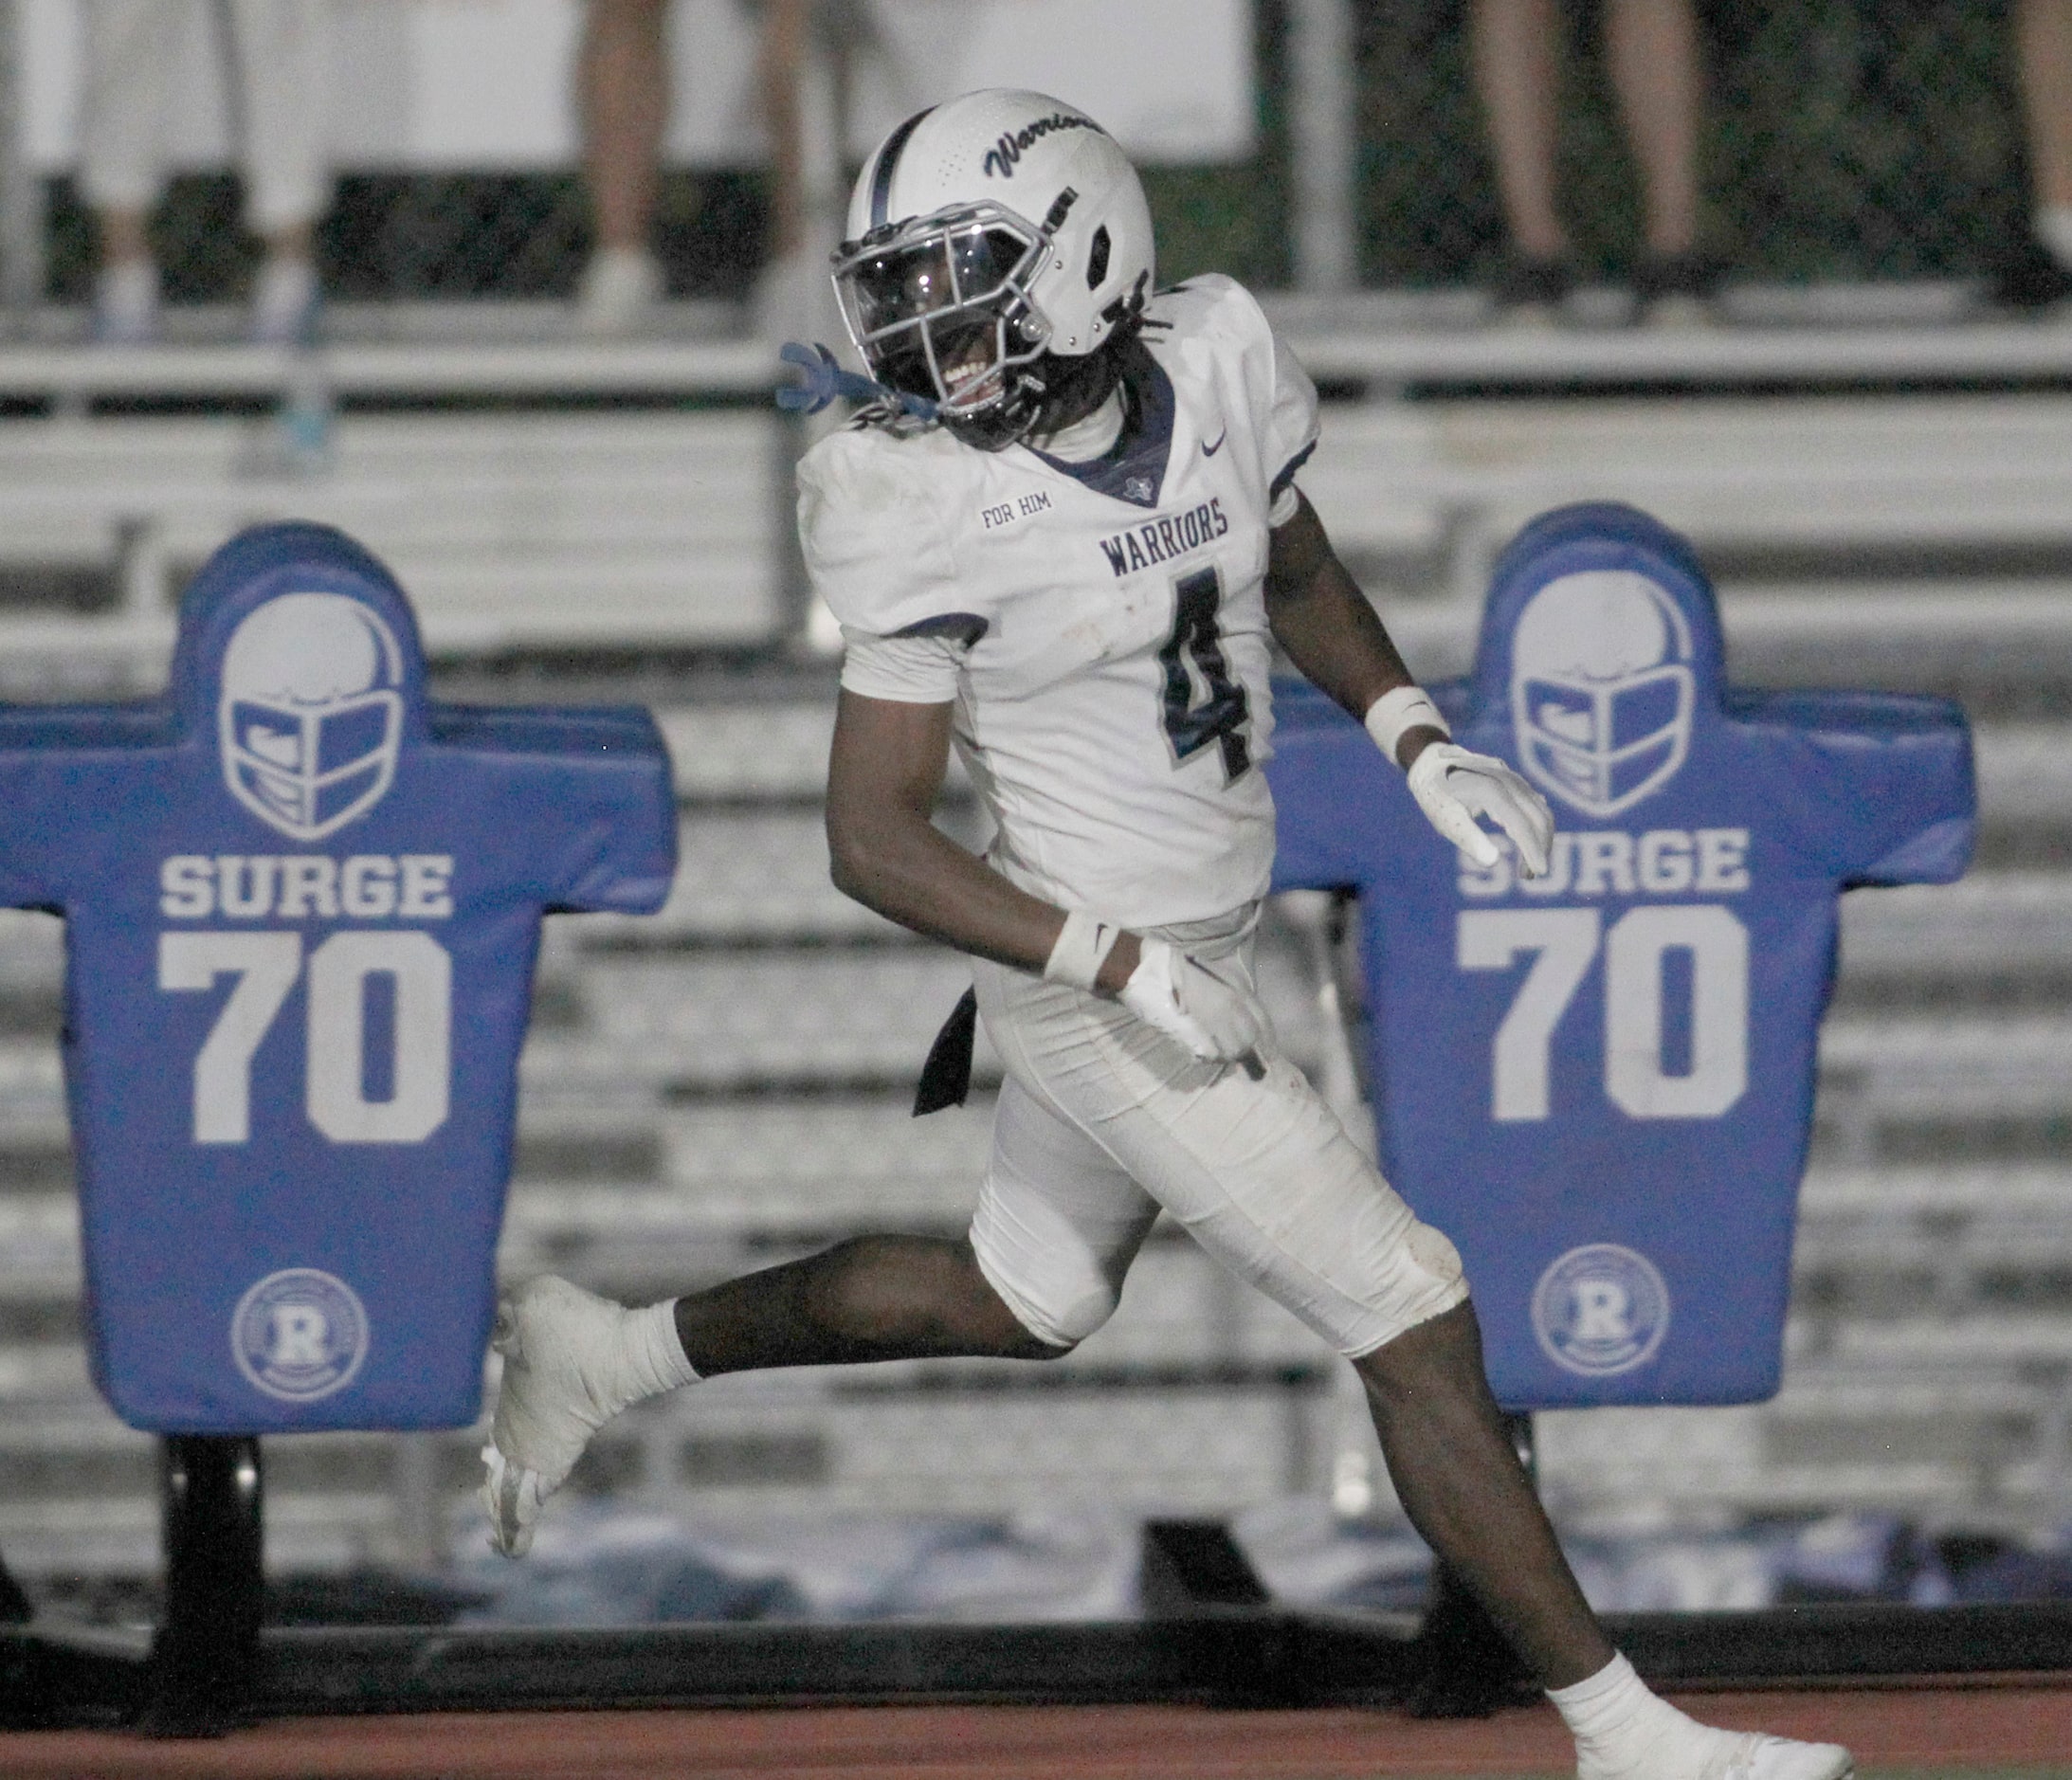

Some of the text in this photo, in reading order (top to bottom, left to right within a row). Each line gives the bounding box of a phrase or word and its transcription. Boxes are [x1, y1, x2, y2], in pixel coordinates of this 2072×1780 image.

[982, 491, 1052, 529] FOR HIM
[1100, 497, 1228, 577] WARRIORS
[1158, 564, 1252, 785] 4
[159, 854, 455, 917] SURGE
[158, 930, 453, 1143] 70
[1457, 904, 1750, 1122] 70
